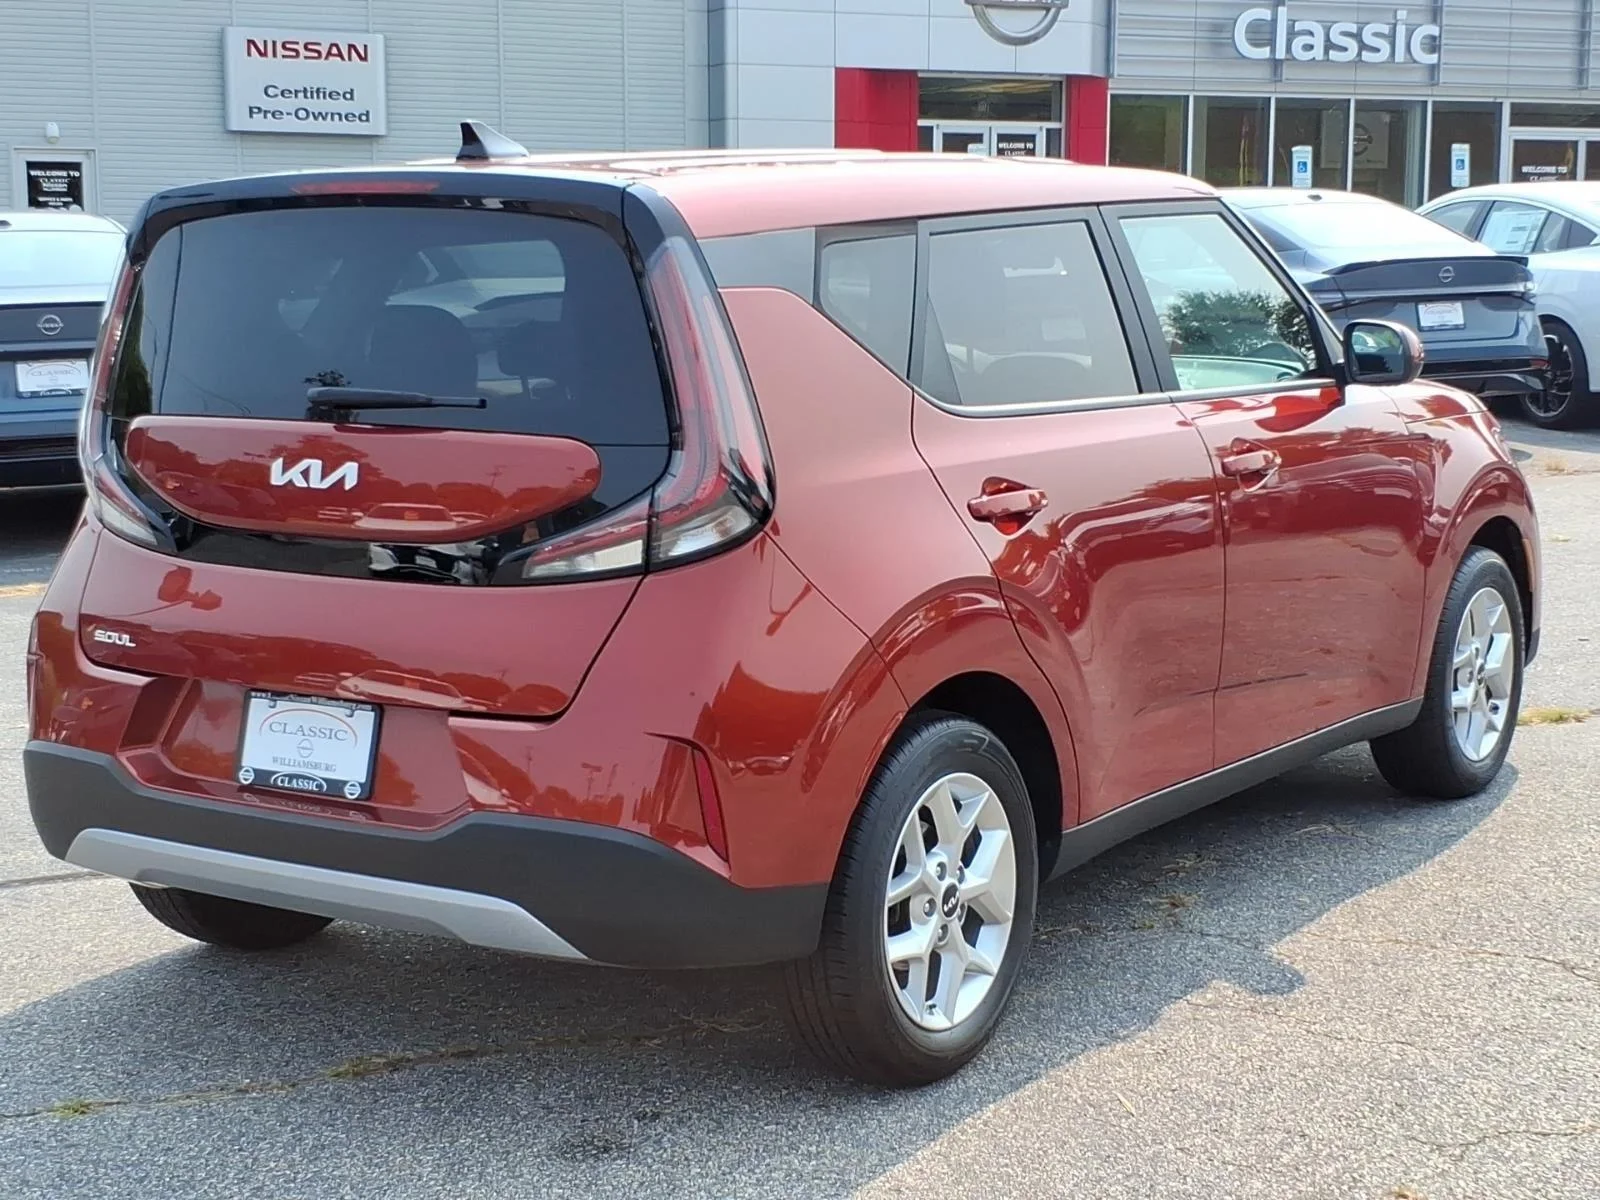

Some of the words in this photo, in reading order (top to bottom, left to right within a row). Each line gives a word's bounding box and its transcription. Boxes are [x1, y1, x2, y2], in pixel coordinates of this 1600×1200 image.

[1234, 6, 1440, 64] Classic
[246, 38, 368, 62] NISSAN
[263, 84, 355, 101] Certified
[248, 105, 370, 123] Pre-Owned
[1521, 165, 1556, 173] WELCOME
[270, 457, 358, 491] KIA
[94, 629, 136, 647] SOUL
[269, 721, 348, 742] CLASSIC
[272, 756, 337, 773] WILLIAMSBURG
[277, 776, 320, 791] CLASSIC
